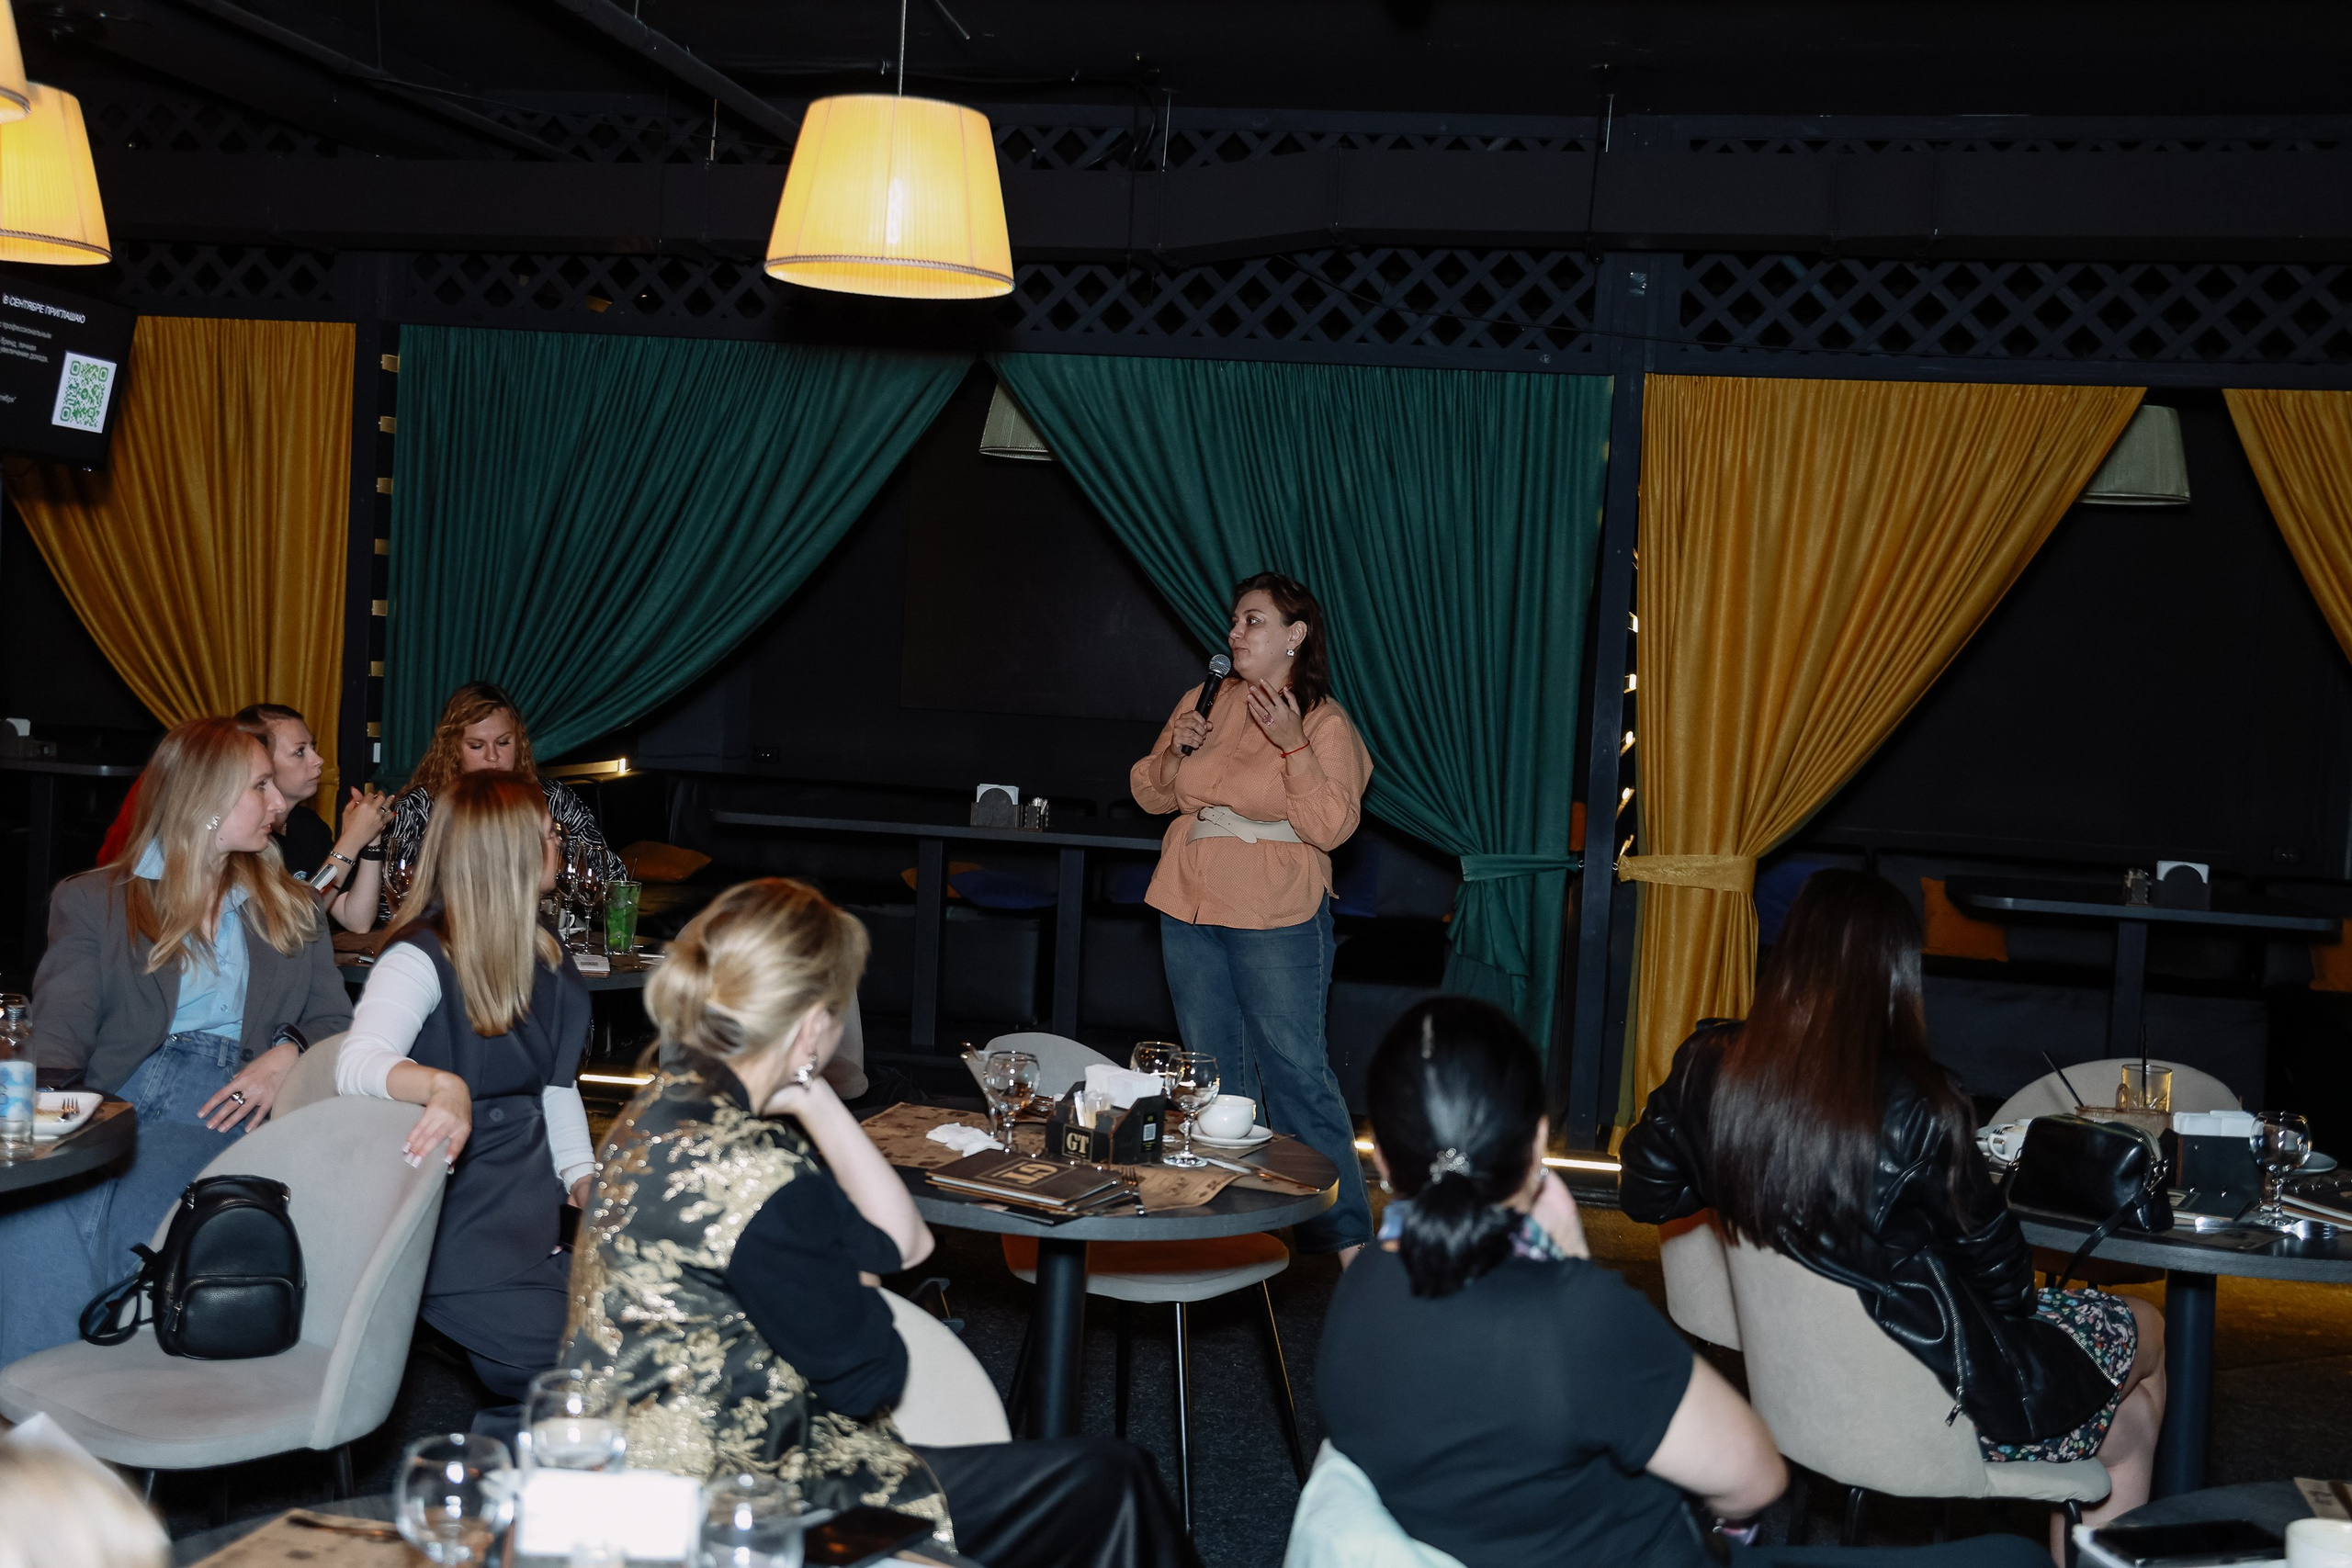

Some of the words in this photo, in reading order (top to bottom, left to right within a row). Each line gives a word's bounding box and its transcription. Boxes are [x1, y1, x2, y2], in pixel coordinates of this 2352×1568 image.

[3, 295, 9, 305] В
[9, 297, 45, 313] СЕНТЯБРЕ
[45, 306, 85, 323] ПРИГЛАШАЮ
[1066, 1132, 1090, 1154] GT
[1001, 1163, 1058, 1185] GT
